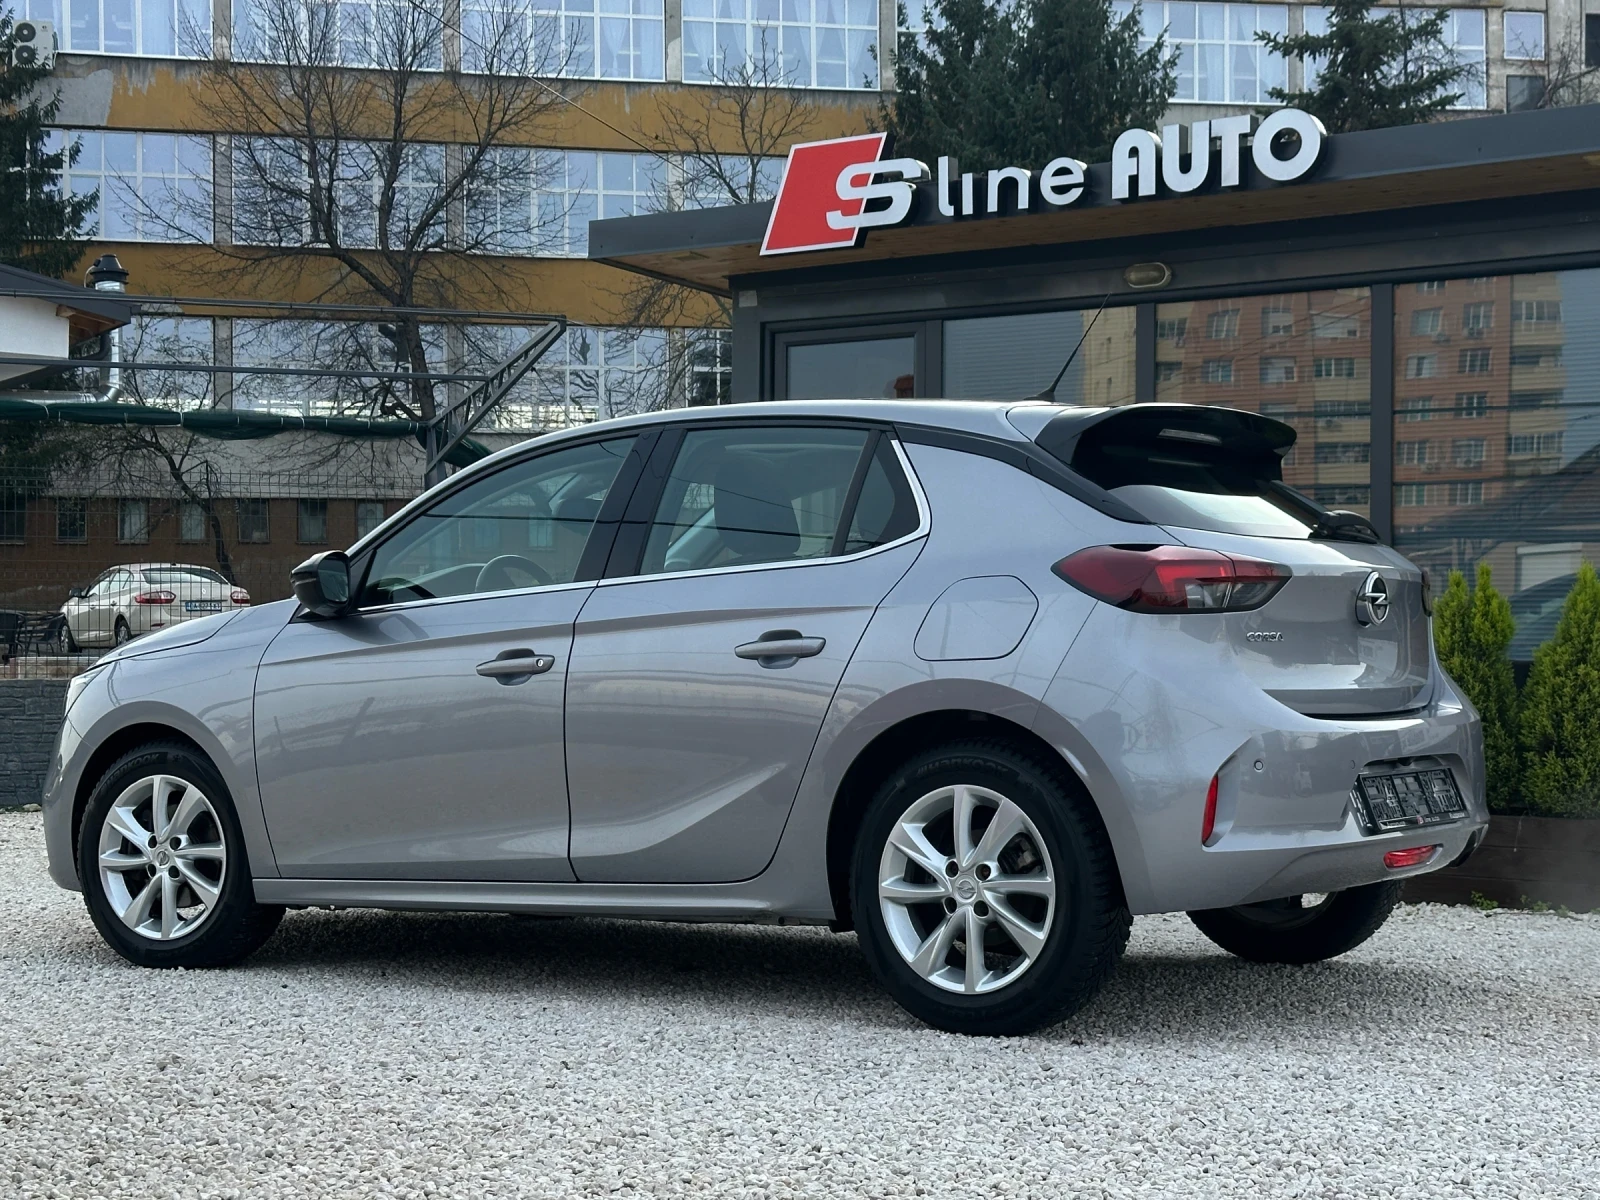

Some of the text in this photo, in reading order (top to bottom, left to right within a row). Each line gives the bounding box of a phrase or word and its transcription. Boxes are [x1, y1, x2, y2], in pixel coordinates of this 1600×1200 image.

[826, 108, 1322, 230] S line AUTO
[1246, 631, 1284, 642] CORSA
